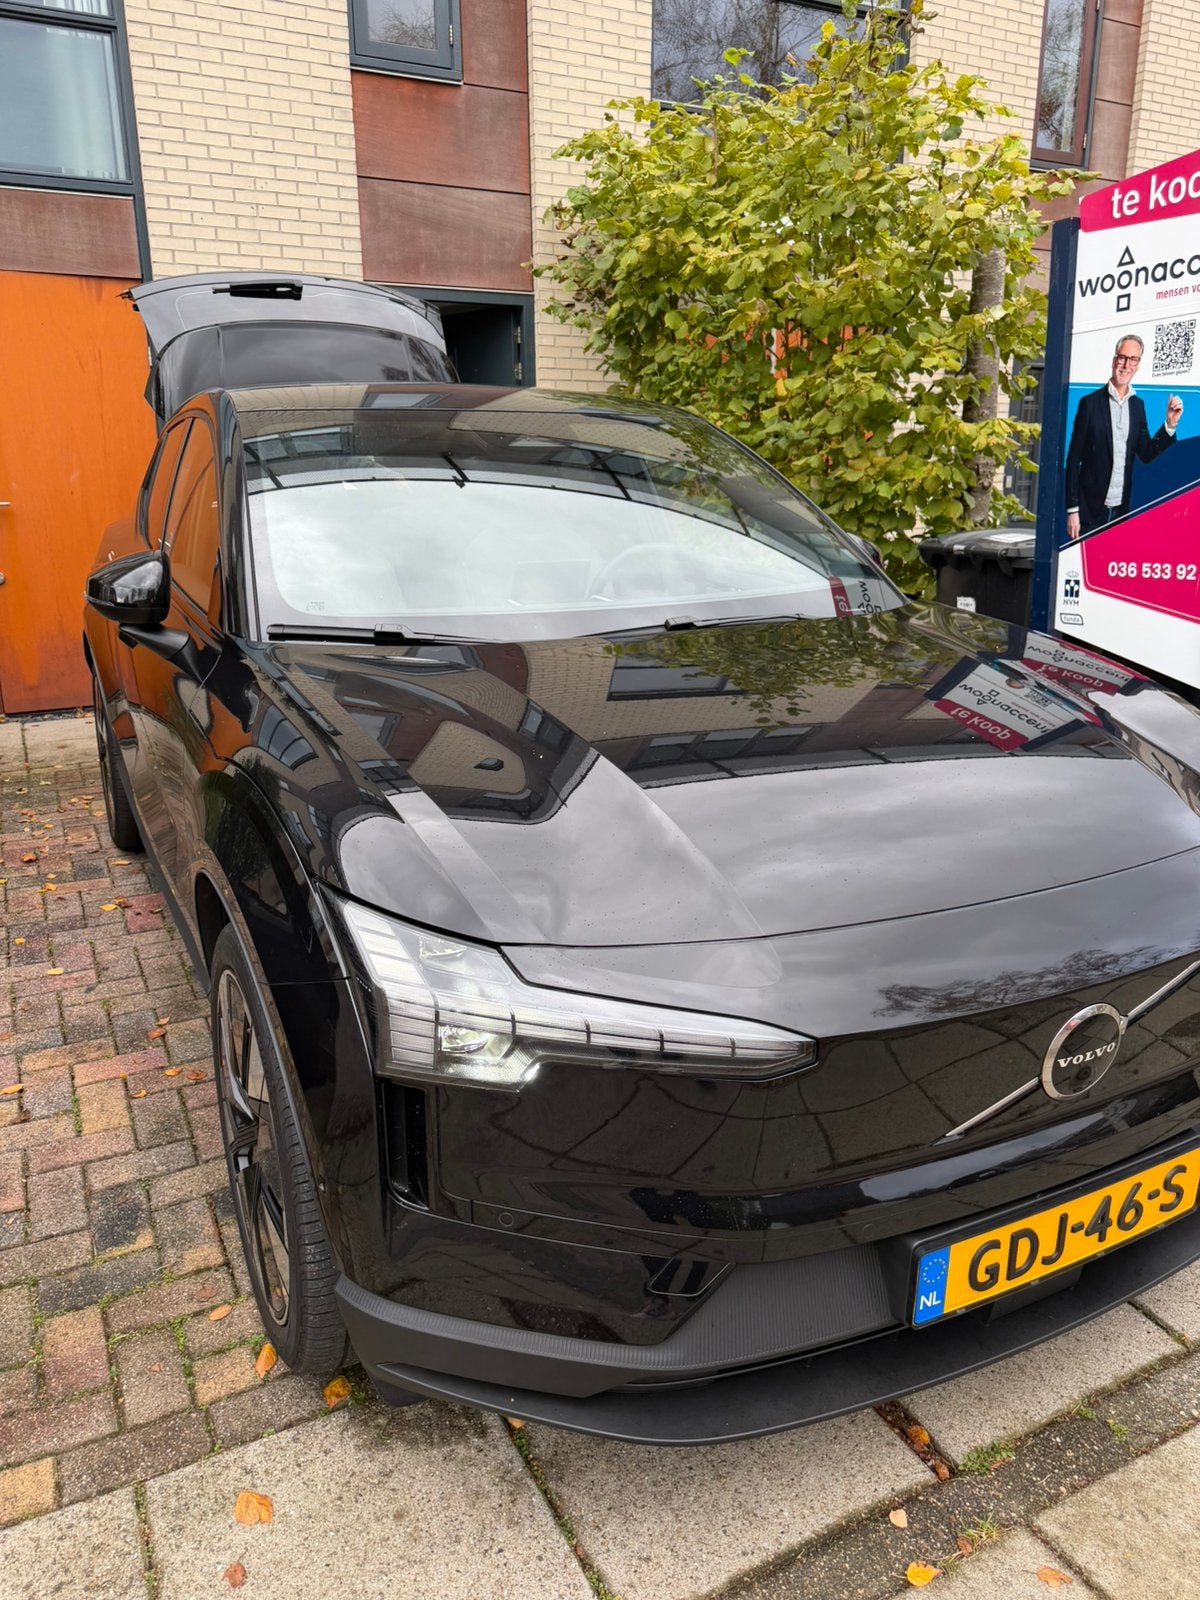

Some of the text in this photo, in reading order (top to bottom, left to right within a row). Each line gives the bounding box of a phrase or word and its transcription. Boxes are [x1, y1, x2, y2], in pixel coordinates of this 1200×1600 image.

[1111, 187, 1140, 219] te
[1156, 286, 1189, 300] mensen
[1108, 562, 1197, 581] 036 533 92
[1057, 1042, 1116, 1068] VOLVO
[968, 1164, 1187, 1293] GDJ-46-S
[919, 1290, 942, 1310] NL
